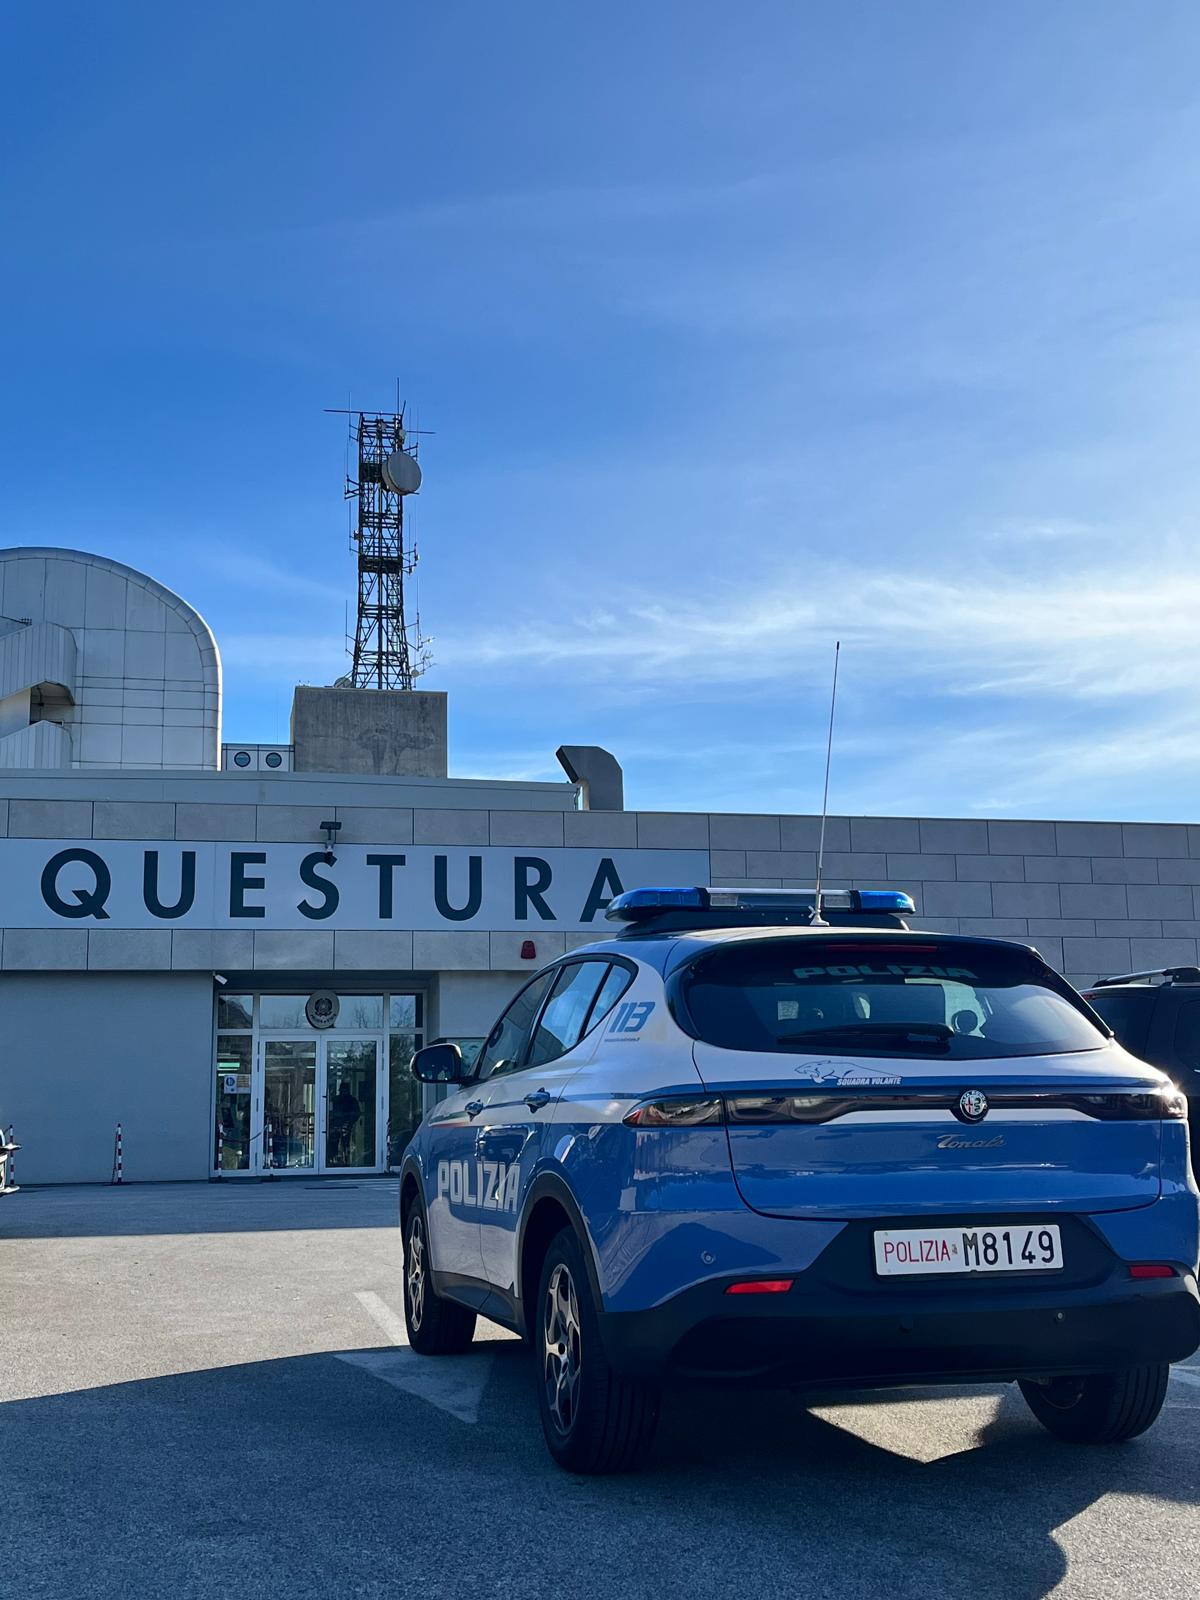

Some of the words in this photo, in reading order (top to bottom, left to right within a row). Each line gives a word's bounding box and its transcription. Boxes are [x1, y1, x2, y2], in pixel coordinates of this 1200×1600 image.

[41, 848, 625, 922] QUESTURA
[793, 965, 979, 979] POLIZIA
[608, 1001, 656, 1033] 113
[836, 1078, 870, 1086] SQUADRA
[871, 1077, 902, 1085] VOLANTE
[937, 1134, 1006, 1149] Tonale
[437, 1160, 520, 1214] POLIZIA
[884, 1240, 951, 1263] POLIZIA
[962, 1230, 1055, 1266] M8149
